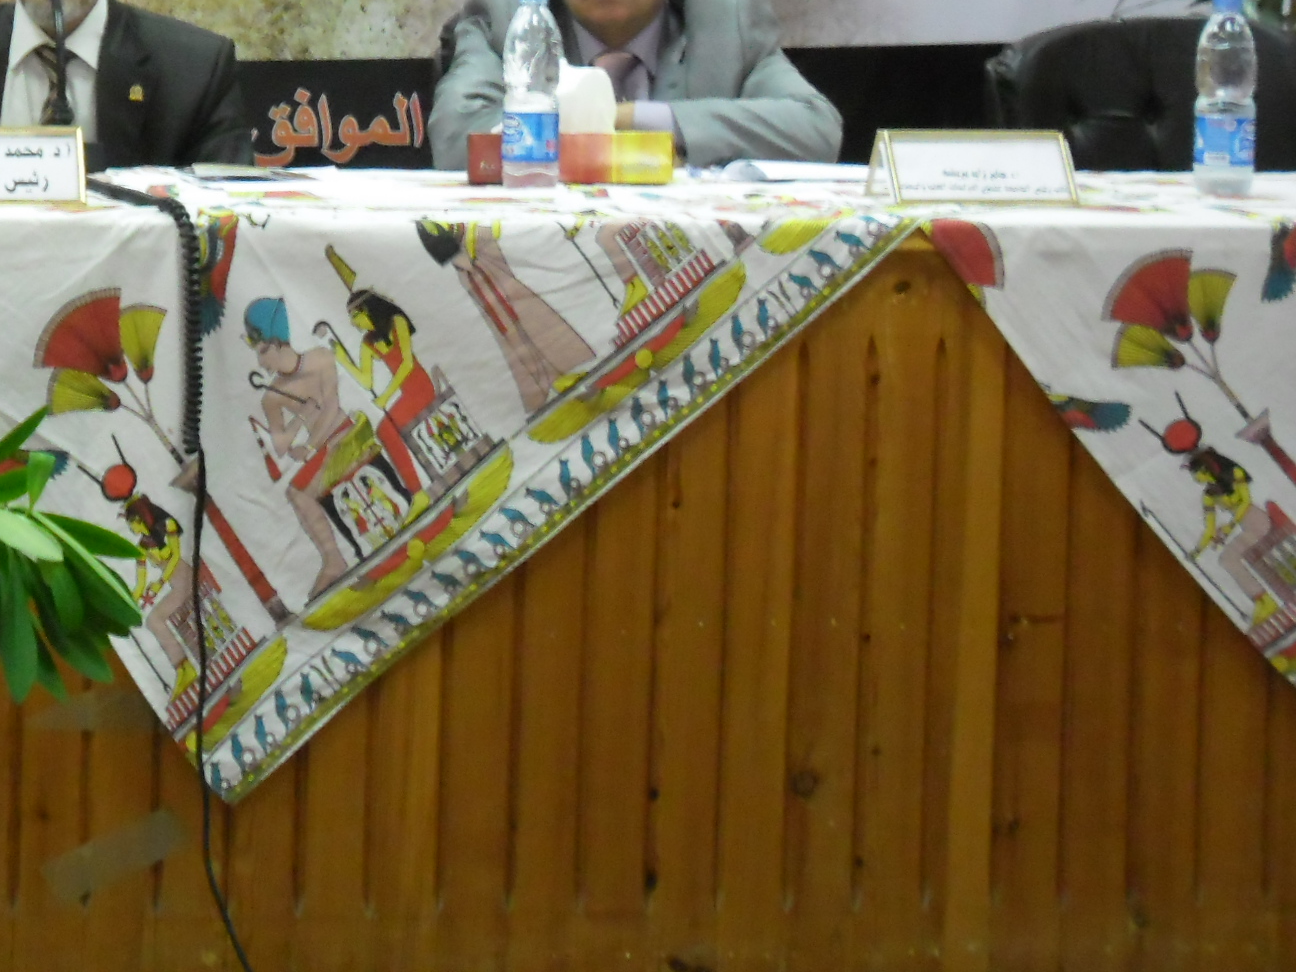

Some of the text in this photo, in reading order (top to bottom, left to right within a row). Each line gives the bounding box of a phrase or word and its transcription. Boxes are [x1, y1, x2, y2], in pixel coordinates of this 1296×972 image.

[251, 86, 425, 168] الموافق
[5, 146, 43, 158] محمد
[5, 169, 49, 194] رئيس
